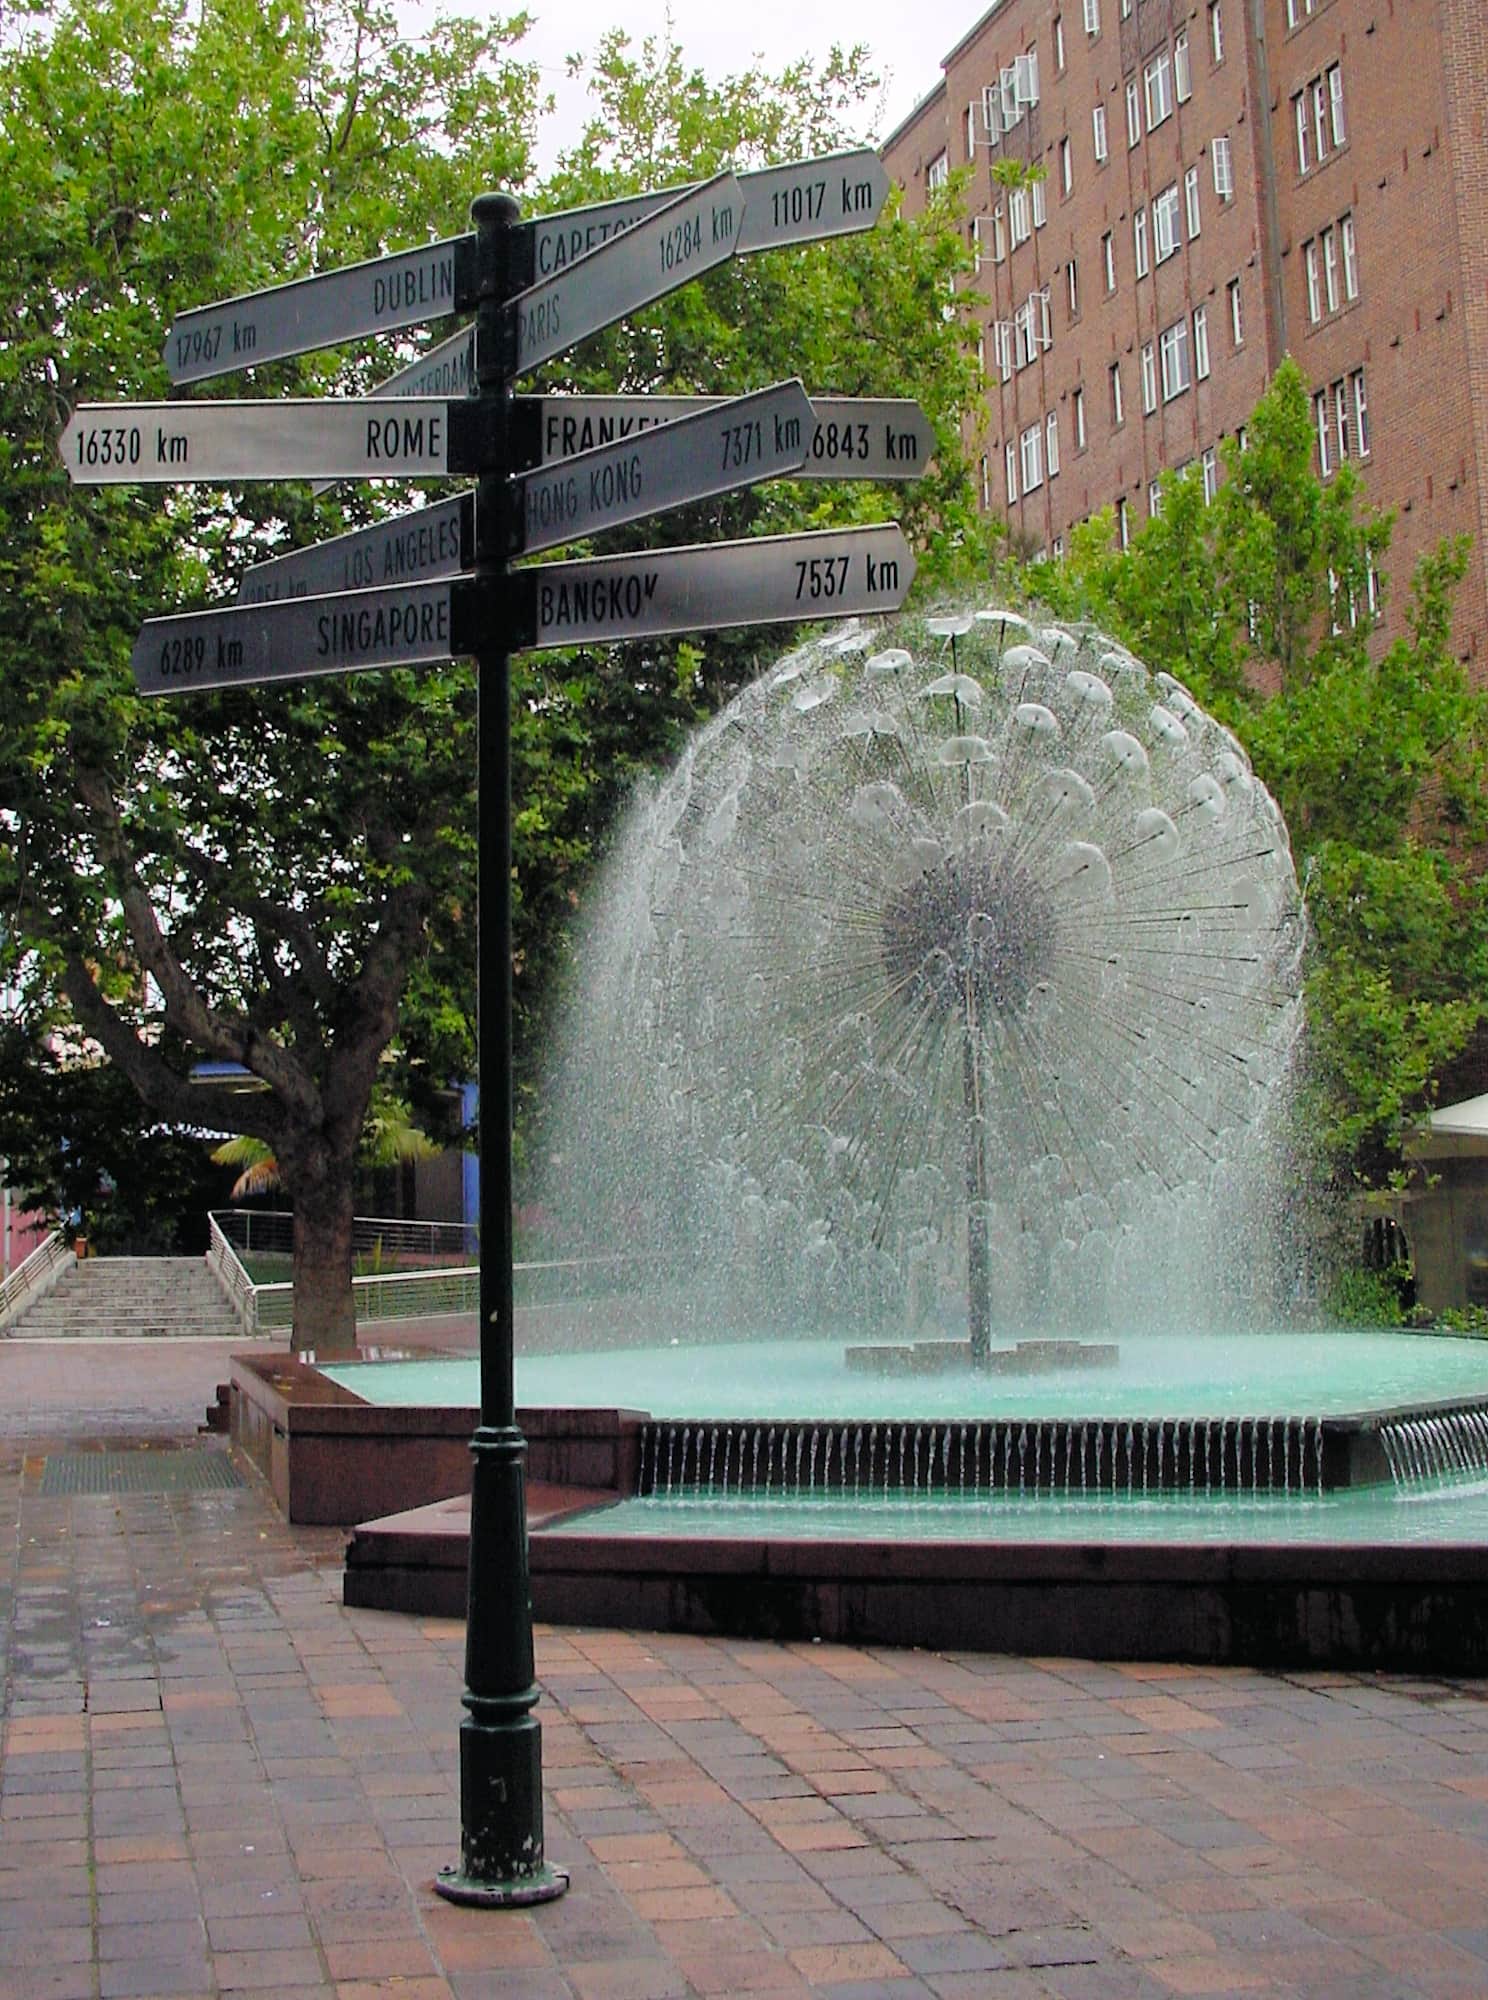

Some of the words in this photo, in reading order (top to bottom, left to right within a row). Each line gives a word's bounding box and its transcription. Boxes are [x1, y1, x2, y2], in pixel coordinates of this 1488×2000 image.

[771, 182, 827, 227] 11017
[842, 178, 872, 214] km
[659, 216, 701, 273] 16284
[711, 206, 733, 246] km
[176, 325, 223, 368] 17967
[233, 321, 257, 349] km
[374, 258, 453, 316] DUBLIN
[77, 428, 142, 466] 16330
[157, 427, 188, 464] km
[366, 417, 441, 459] ROME
[527, 478, 577, 528] HONG
[590, 455, 643, 510] KONG
[721, 420, 762, 472] 7371
[774, 413, 801, 453] km
[546, 416, 669, 456] FRANK
[806, 422, 869, 459] 6843
[886, 424, 917, 460] km
[344, 545, 374, 587] LOS
[384, 516, 459, 579] ANGELES
[794, 556, 850, 600] 7537
[866, 553, 899, 593] km
[161, 636, 205, 676] 6289
[217, 632, 244, 667] km
[317, 600, 448, 657] SINGAPORE
